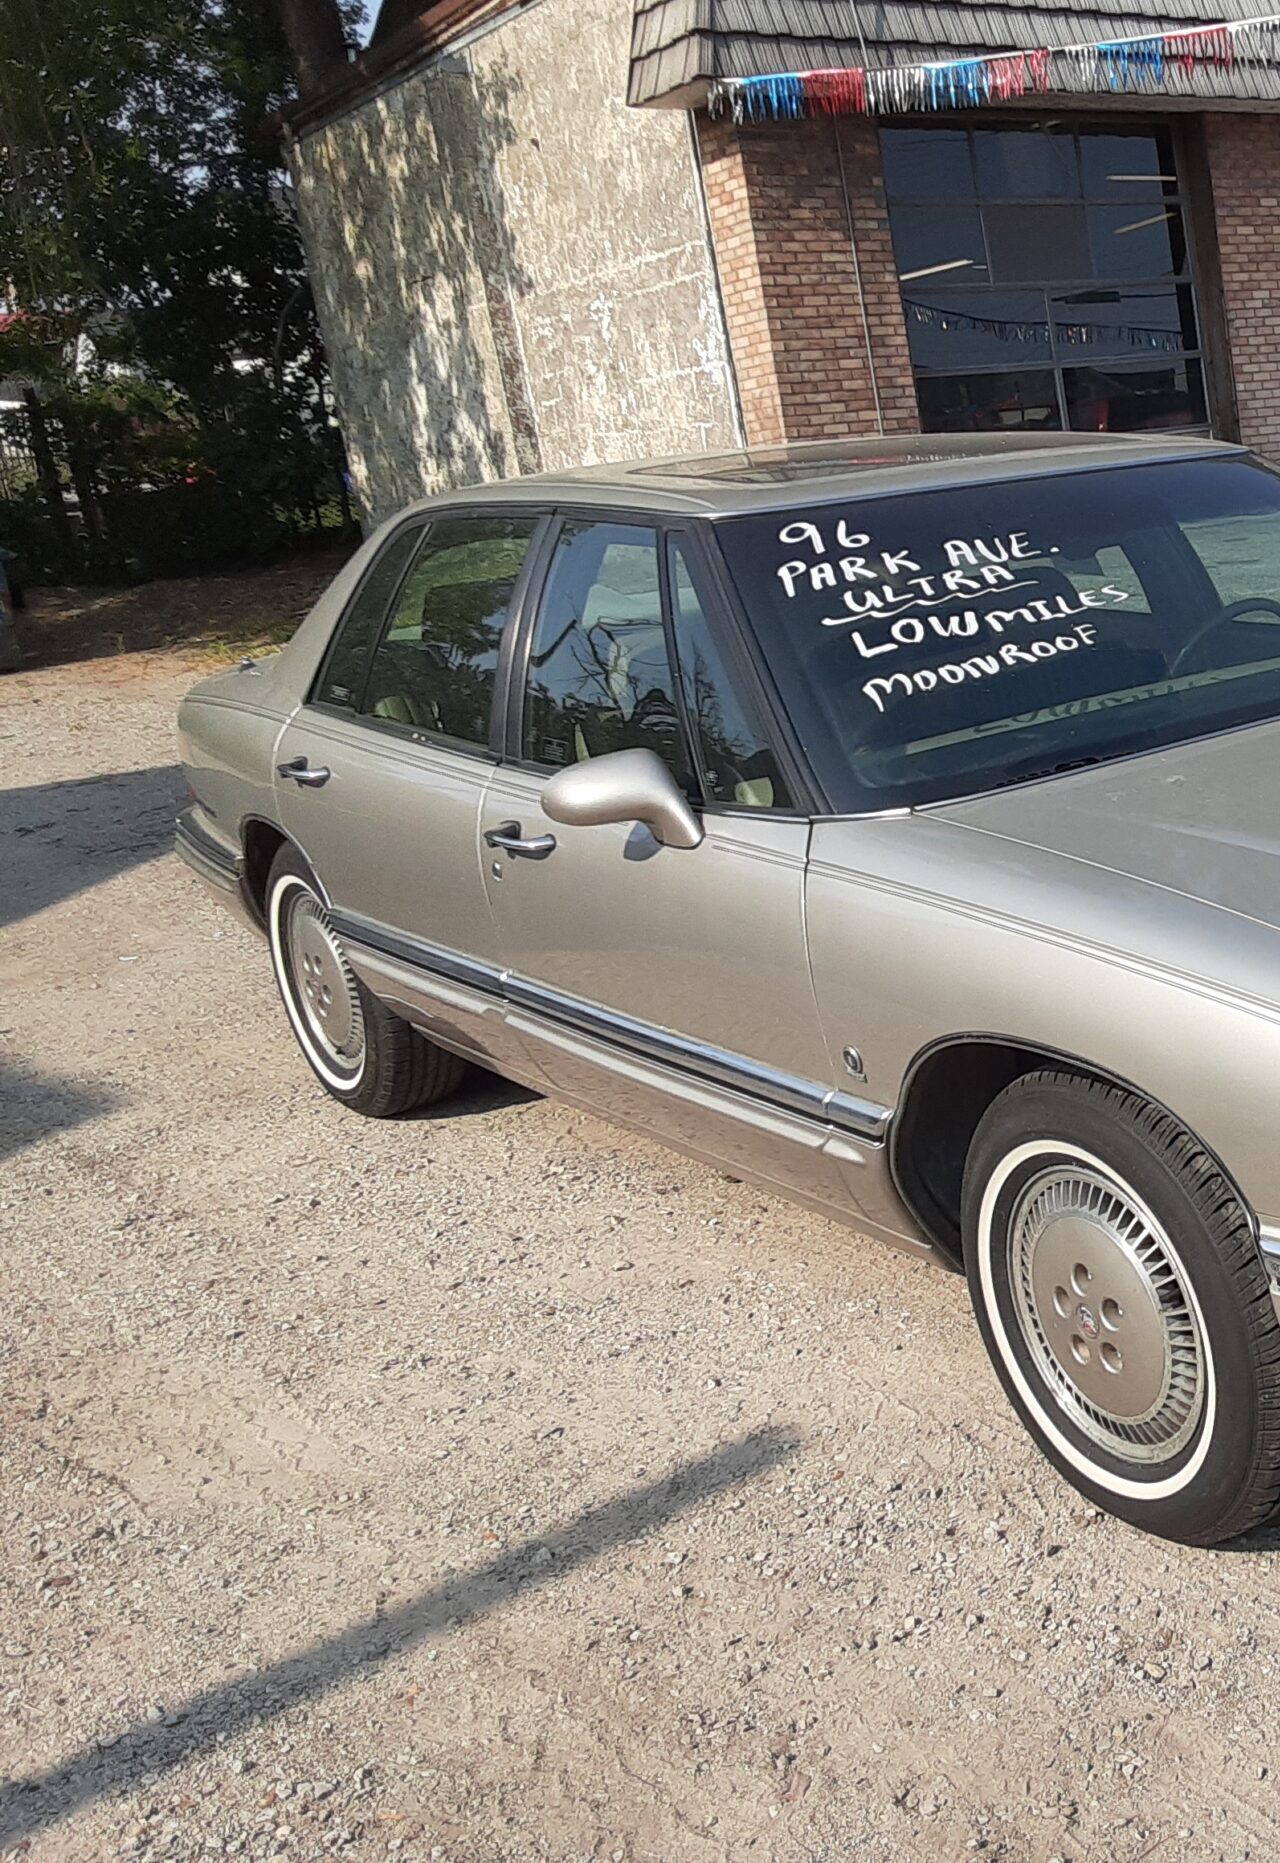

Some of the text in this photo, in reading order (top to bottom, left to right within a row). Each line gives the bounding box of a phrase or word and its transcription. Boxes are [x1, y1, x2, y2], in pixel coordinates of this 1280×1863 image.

[778, 519, 870, 554] 96
[777, 549, 921, 598] PARK
[843, 564, 1015, 614] ULTRA
